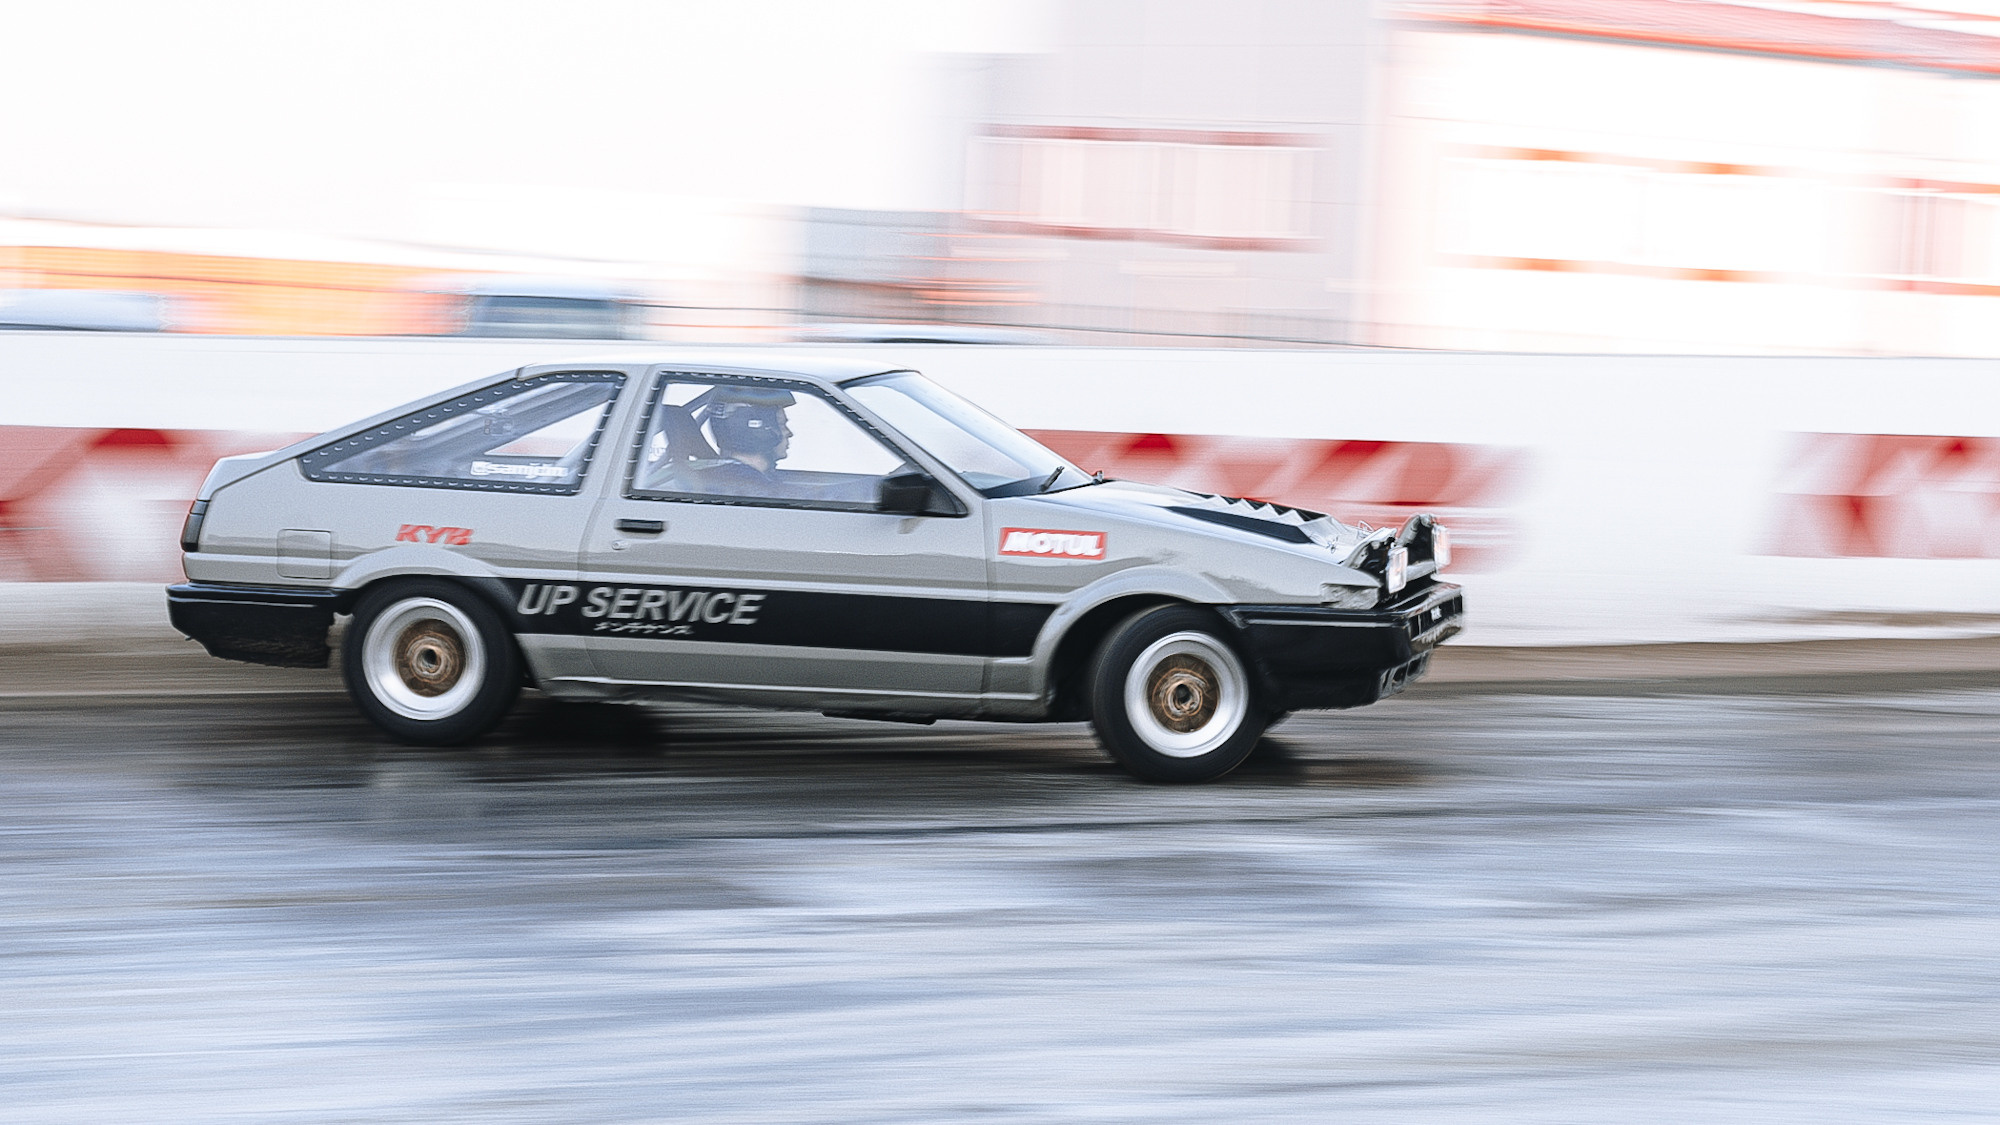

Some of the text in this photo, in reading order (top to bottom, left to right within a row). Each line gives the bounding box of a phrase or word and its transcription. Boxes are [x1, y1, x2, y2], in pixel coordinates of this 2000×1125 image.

[395, 524, 474, 545] KYB
[1001, 531, 1104, 556] MOTUL
[517, 584, 767, 625] UP SERVICE
